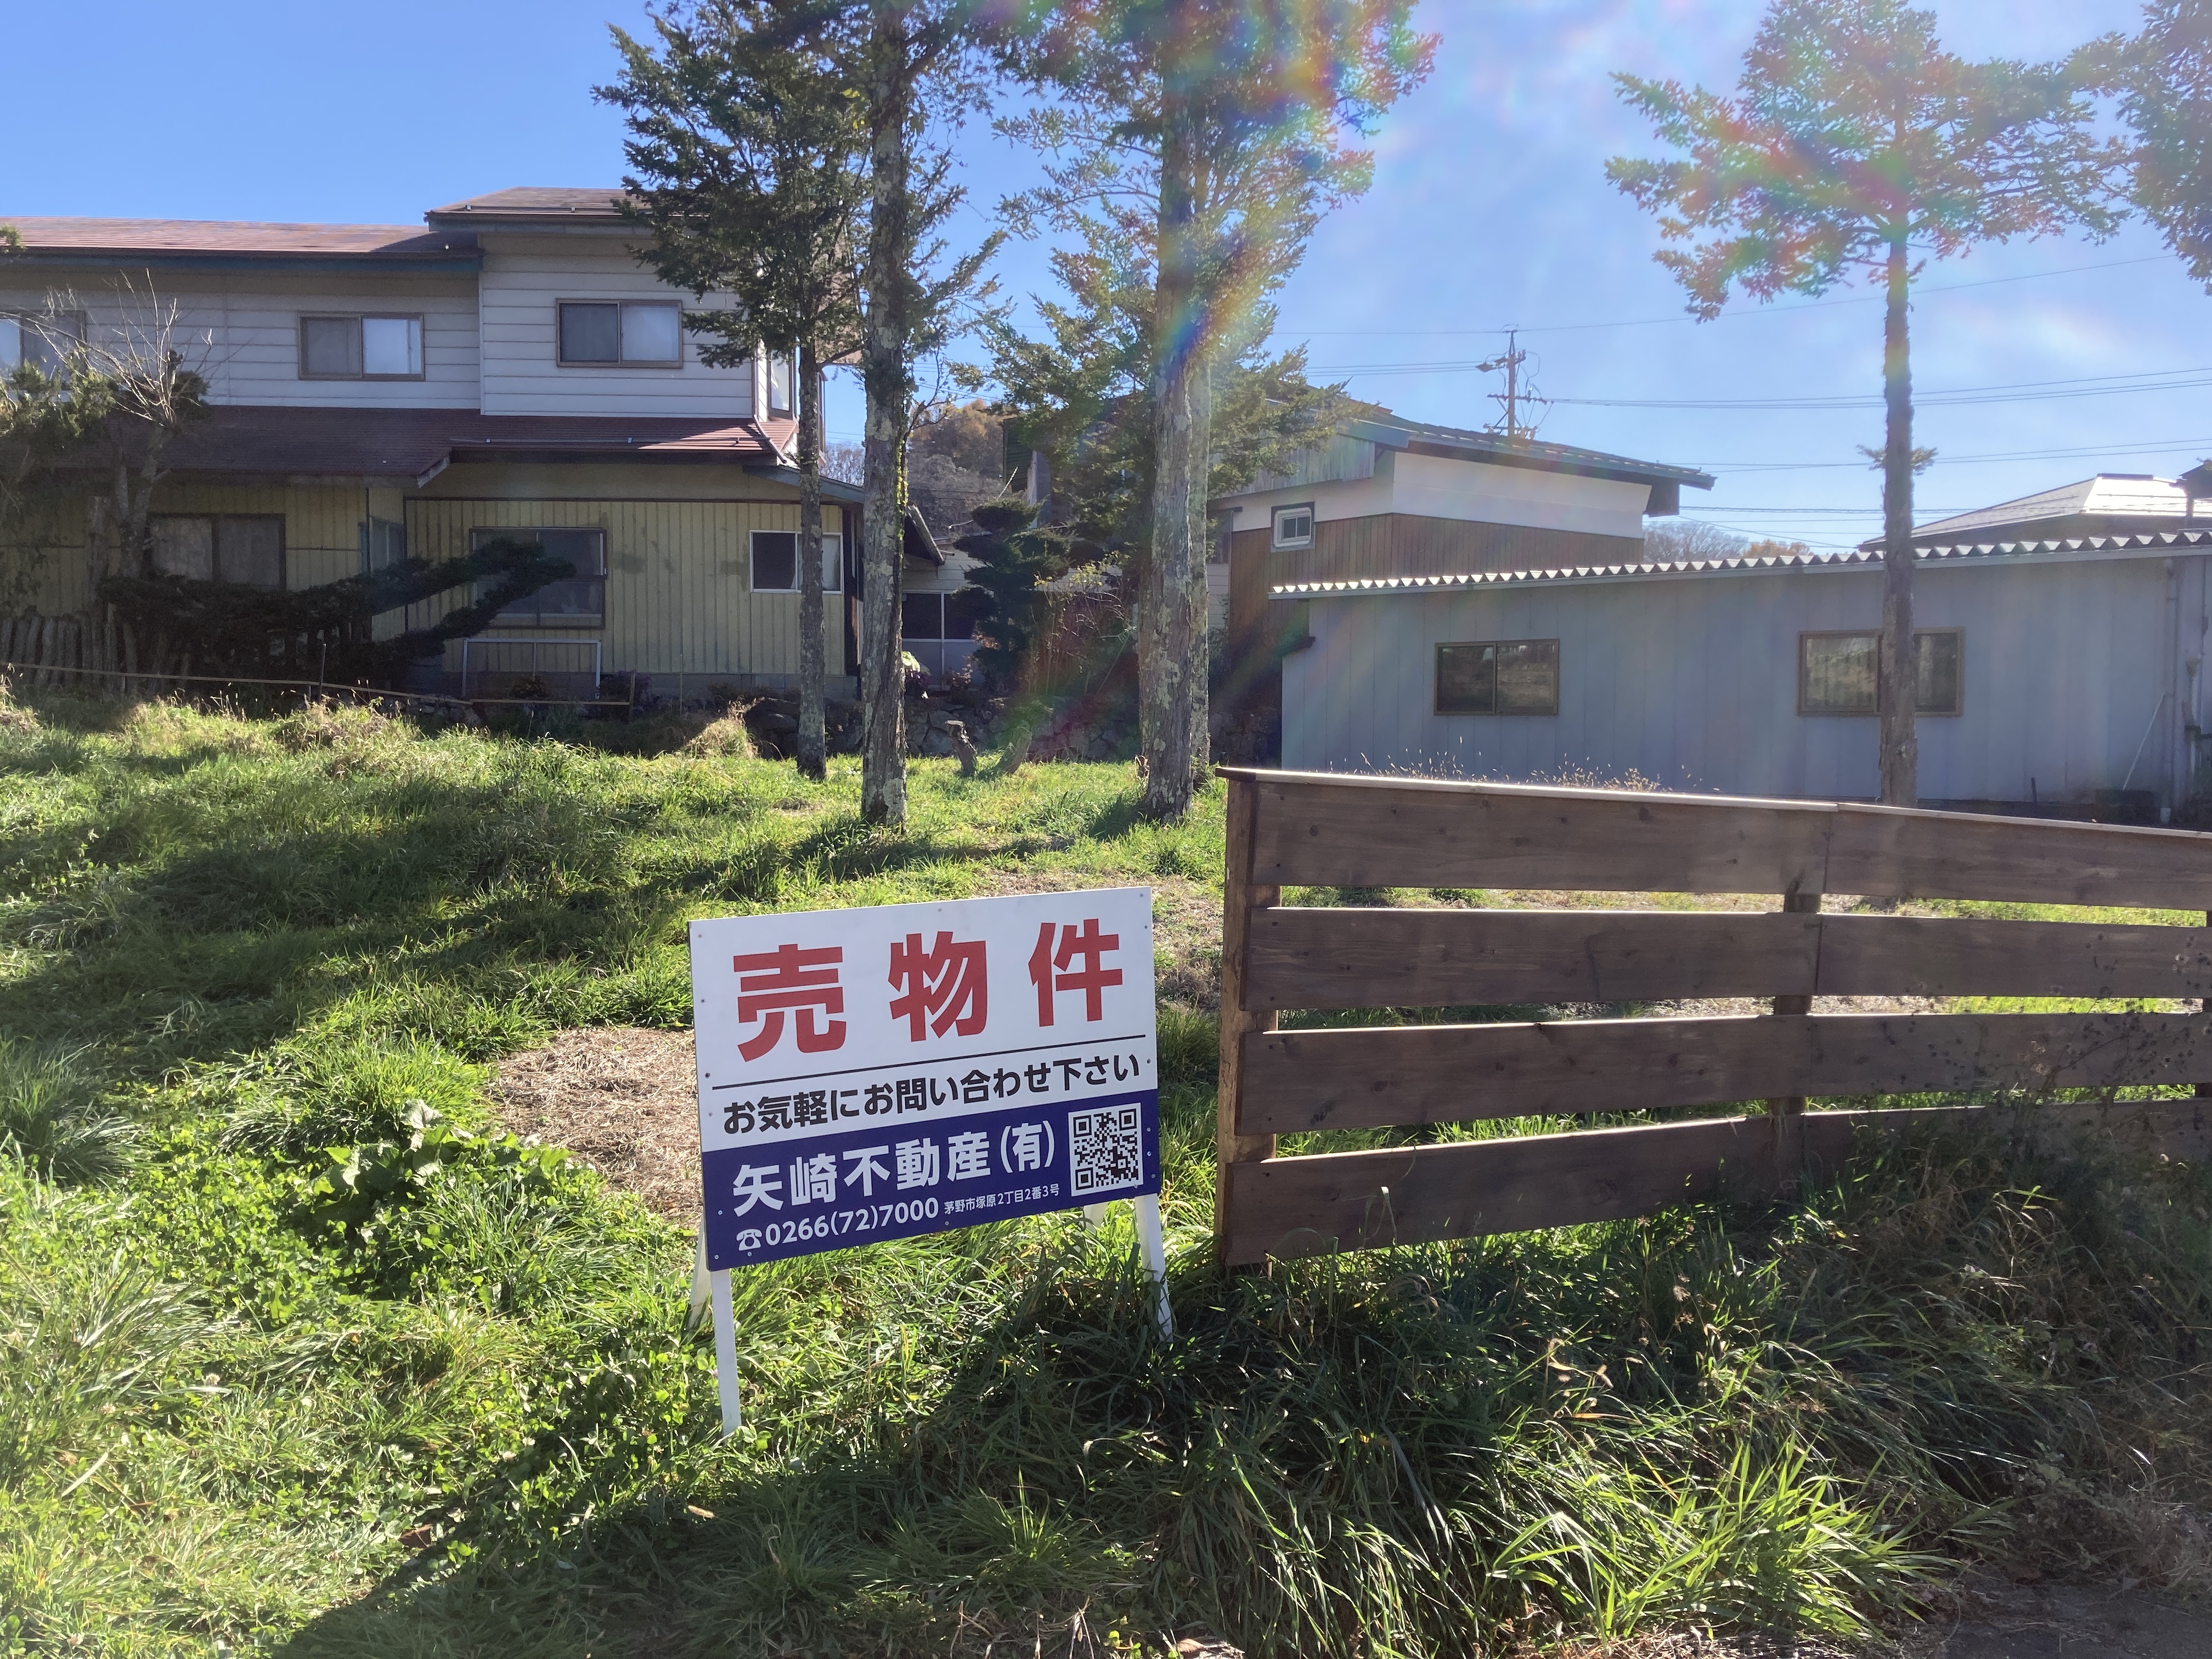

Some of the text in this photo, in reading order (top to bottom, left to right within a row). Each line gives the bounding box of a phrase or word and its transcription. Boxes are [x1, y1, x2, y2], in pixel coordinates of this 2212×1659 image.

[733, 918, 1123, 1063] 売物件
[724, 1054, 1140, 1135] お気軽にお問い合わせ下さい
[765, 1197, 939, 1246] 0266(72)7000
[944, 1183, 1060, 1215] 茅野市塚原2丁目2番3号
